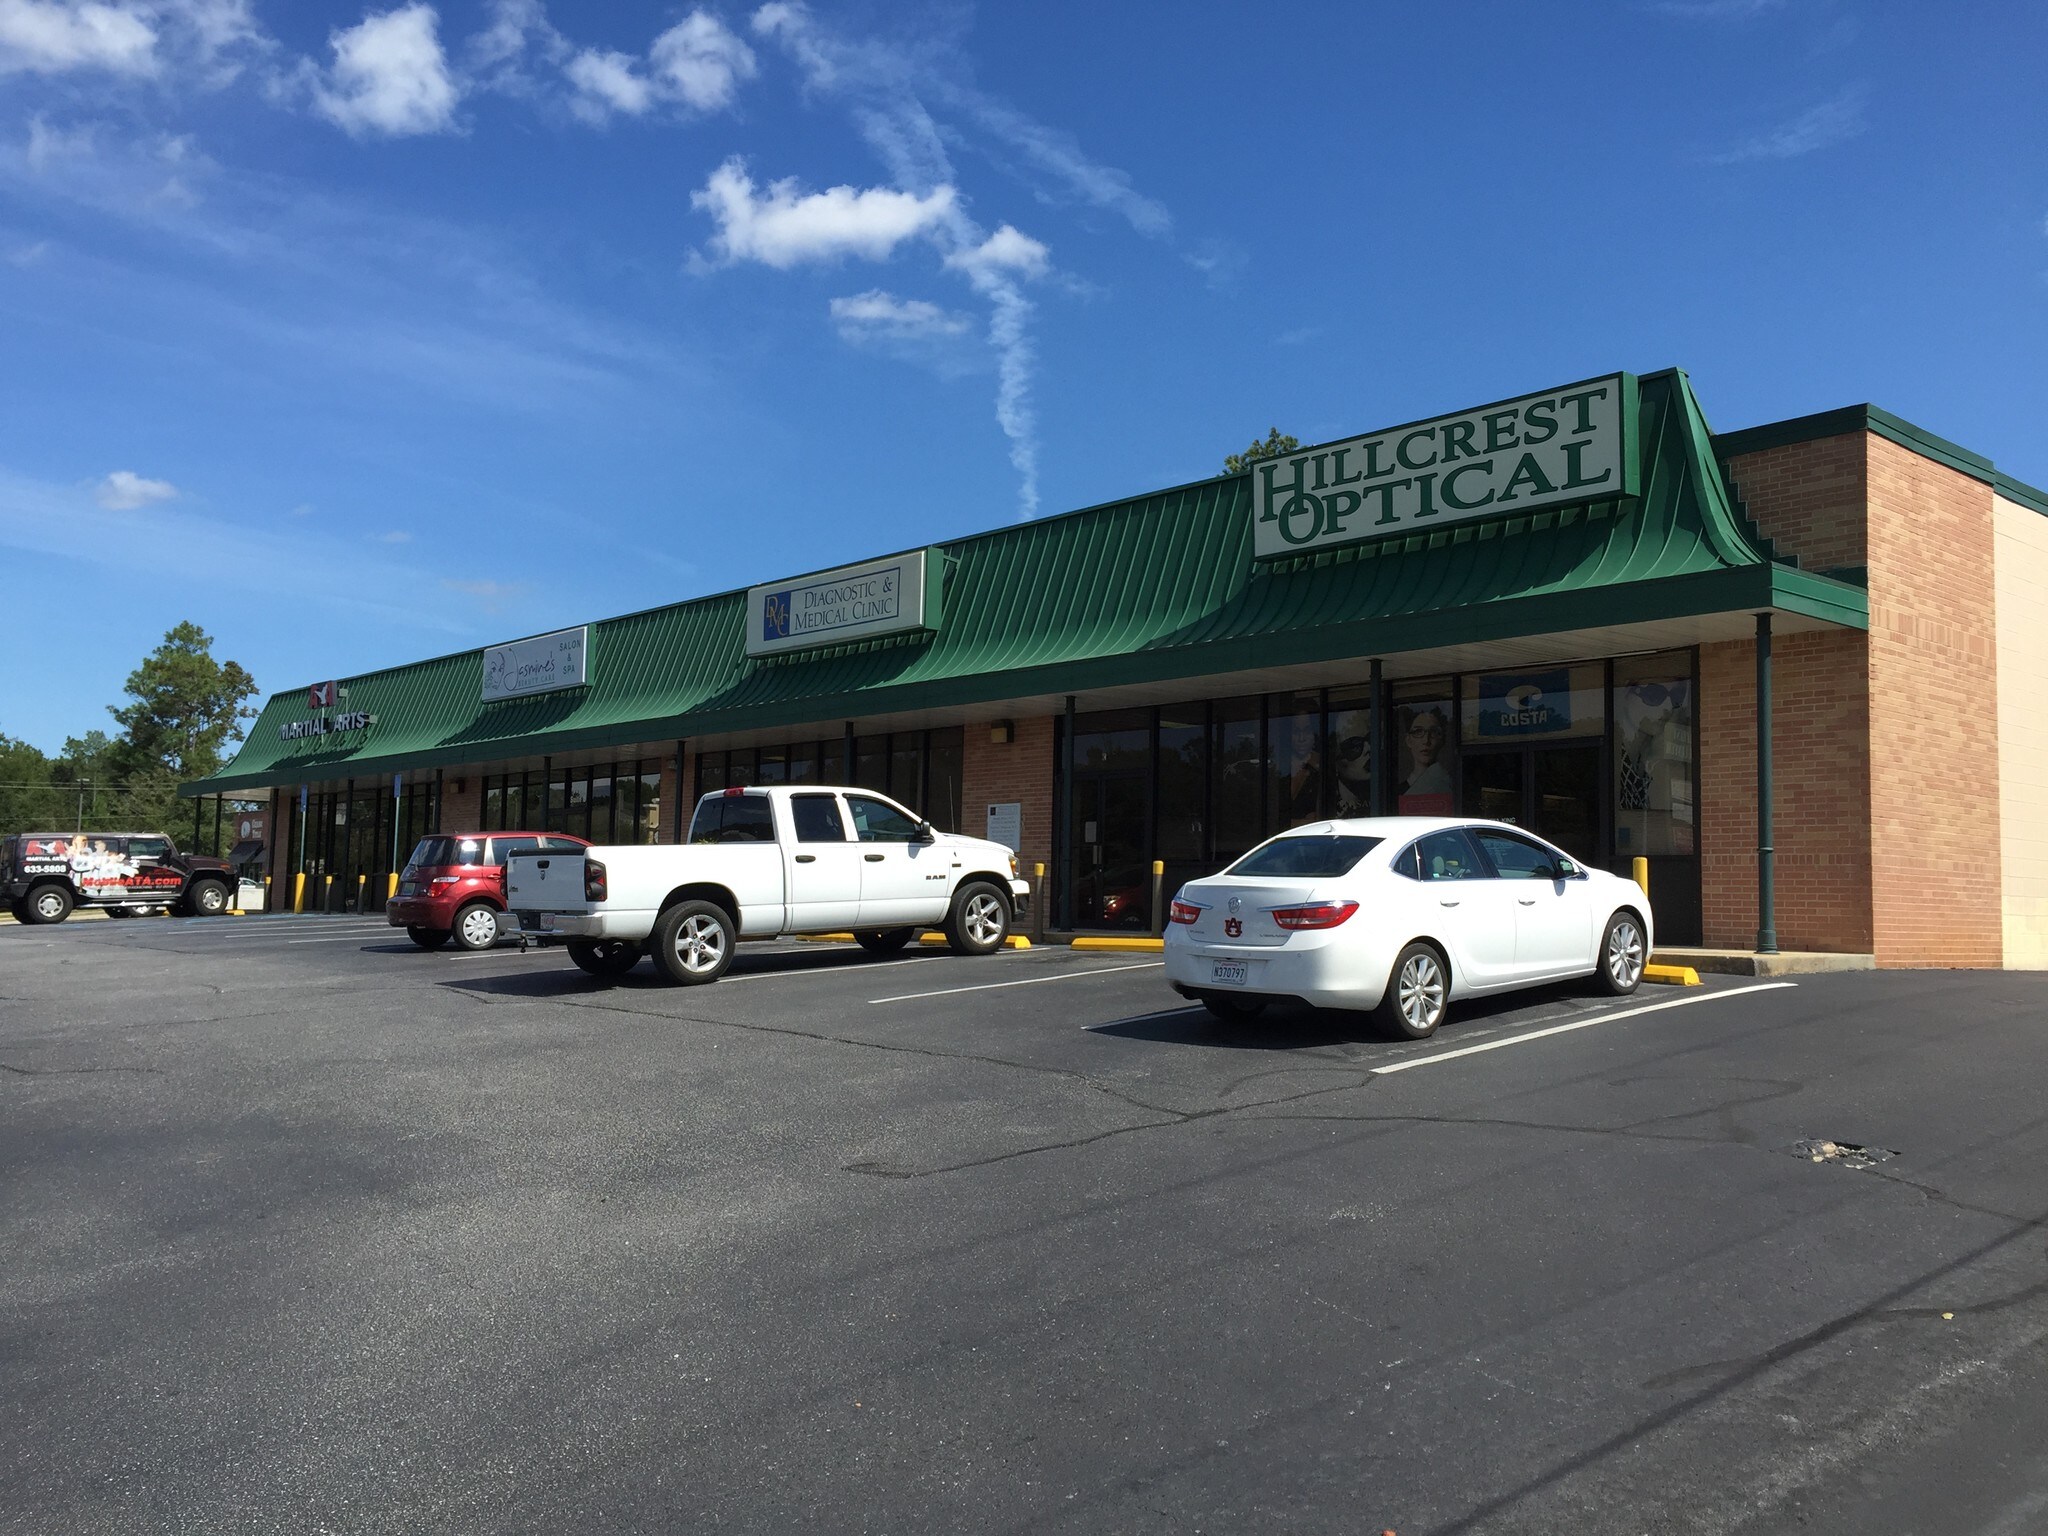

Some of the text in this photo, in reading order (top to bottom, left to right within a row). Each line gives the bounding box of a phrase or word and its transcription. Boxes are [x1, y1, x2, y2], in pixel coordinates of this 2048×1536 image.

[1259, 388, 1608, 523] HILLCREST
[1278, 439, 1612, 545] OPTICAL
[804, 576, 893, 609] DIAGNOSTIC &
[794, 598, 893, 631] MEDICAL CLINIC
[559, 639, 580, 652] SALON
[567, 654, 572, 662] &
[563, 665, 576, 675] SPA
[280, 710, 366, 740] MARTIAL ARTS
[1501, 710, 1548, 727] COSTA
